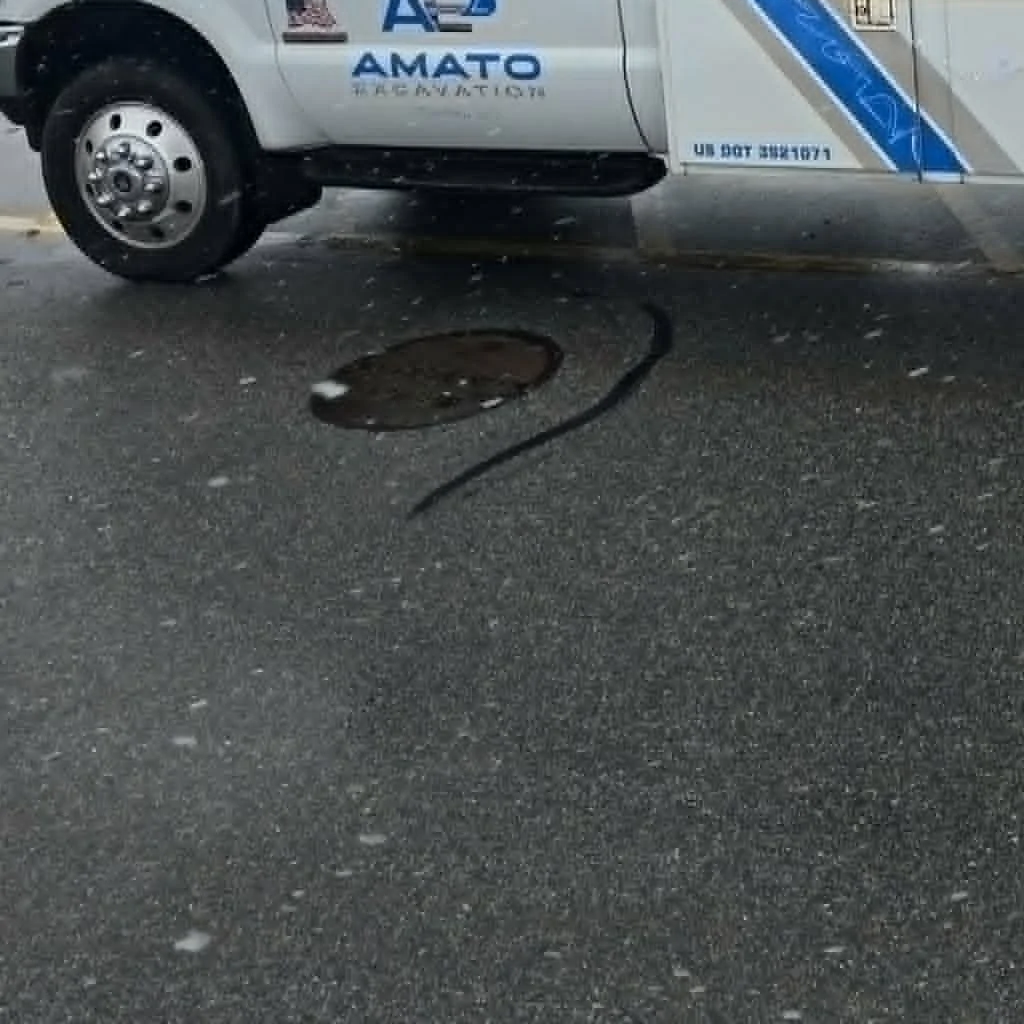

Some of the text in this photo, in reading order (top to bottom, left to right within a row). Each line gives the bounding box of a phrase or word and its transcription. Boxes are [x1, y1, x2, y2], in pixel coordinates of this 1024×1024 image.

[351, 51, 542, 81] AMATO
[693, 143, 715, 157] US
[720, 143, 752, 158] DOT
